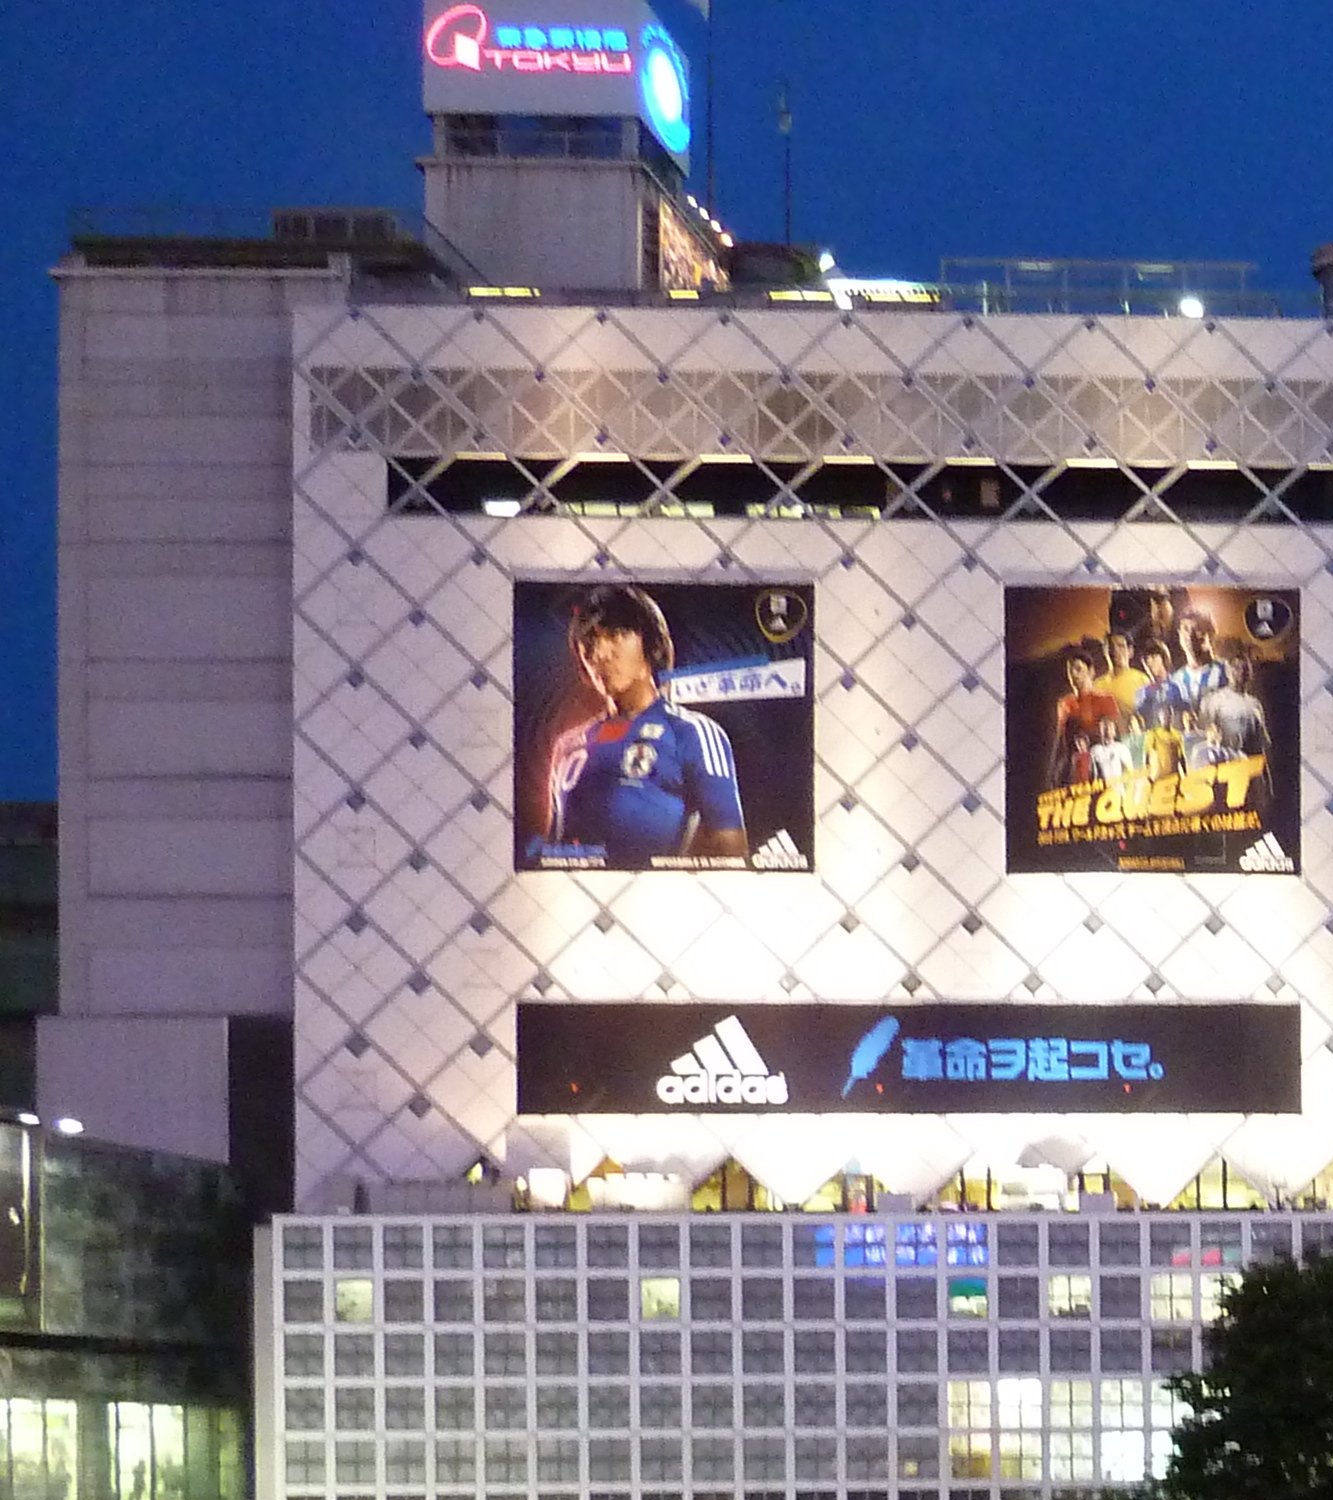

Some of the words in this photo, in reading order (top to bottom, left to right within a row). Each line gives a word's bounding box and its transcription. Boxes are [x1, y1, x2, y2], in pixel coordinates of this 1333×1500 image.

[484, 48, 632, 73] TOKYU
[1037, 796, 1091, 830] THE
[1095, 754, 1267, 825] QUEST
[901, 1036, 1165, 1083] 革命ヲ起コセ。
[656, 1070, 789, 1105] adidas
